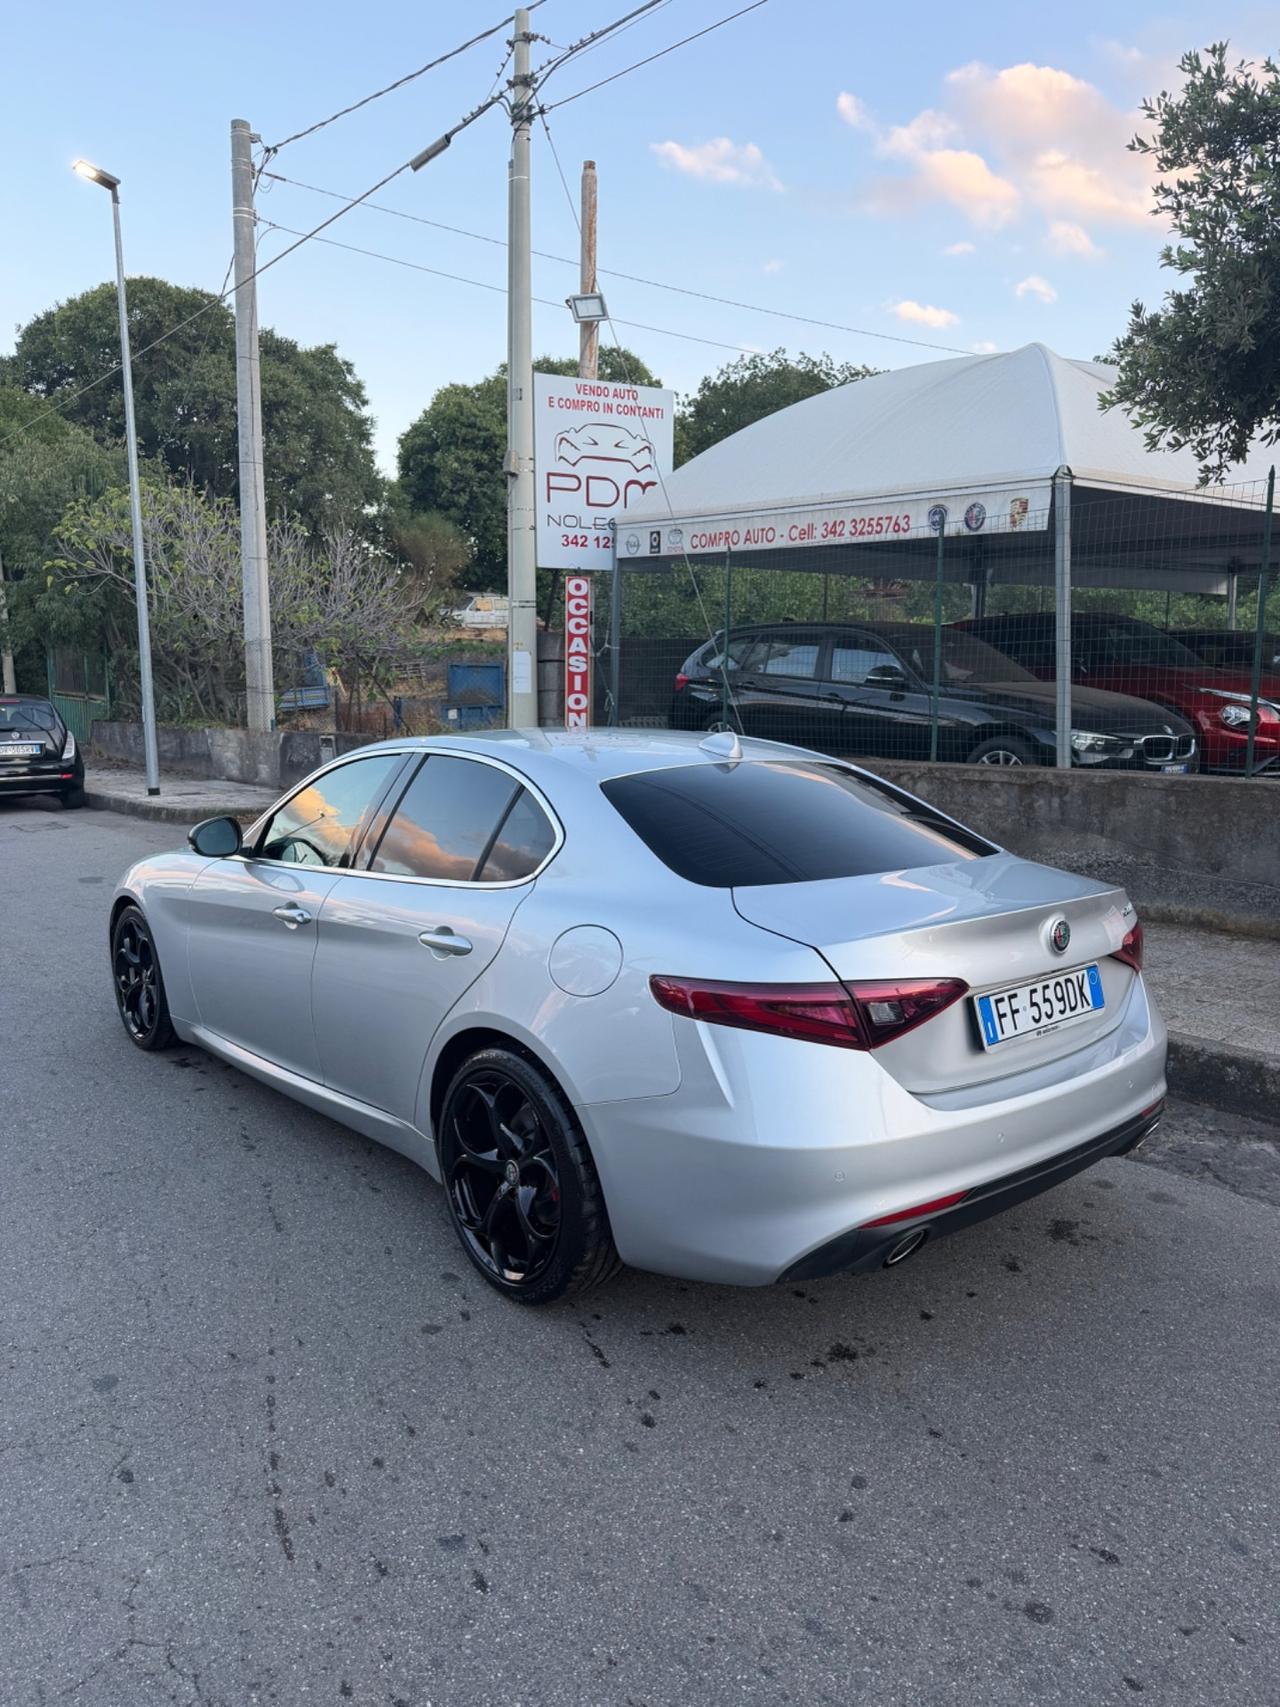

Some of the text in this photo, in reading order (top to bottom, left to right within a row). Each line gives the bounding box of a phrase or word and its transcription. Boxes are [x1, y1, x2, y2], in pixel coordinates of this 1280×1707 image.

[575, 383, 638, 401] VENDO AUTO
[548, 396, 664, 420] E COMPRO IN CONTANTI
[561, 533, 588, 548] 342
[690, 528, 741, 550] COMPRO
[743, 526, 776, 546] AUTO
[788, 523, 817, 541] Cell:
[821, 519, 846, 539] 342
[849, 514, 911, 537] 3255763
[567, 578, 588, 729] OCCASION
[994, 972, 1091, 1035] FF 559DK
